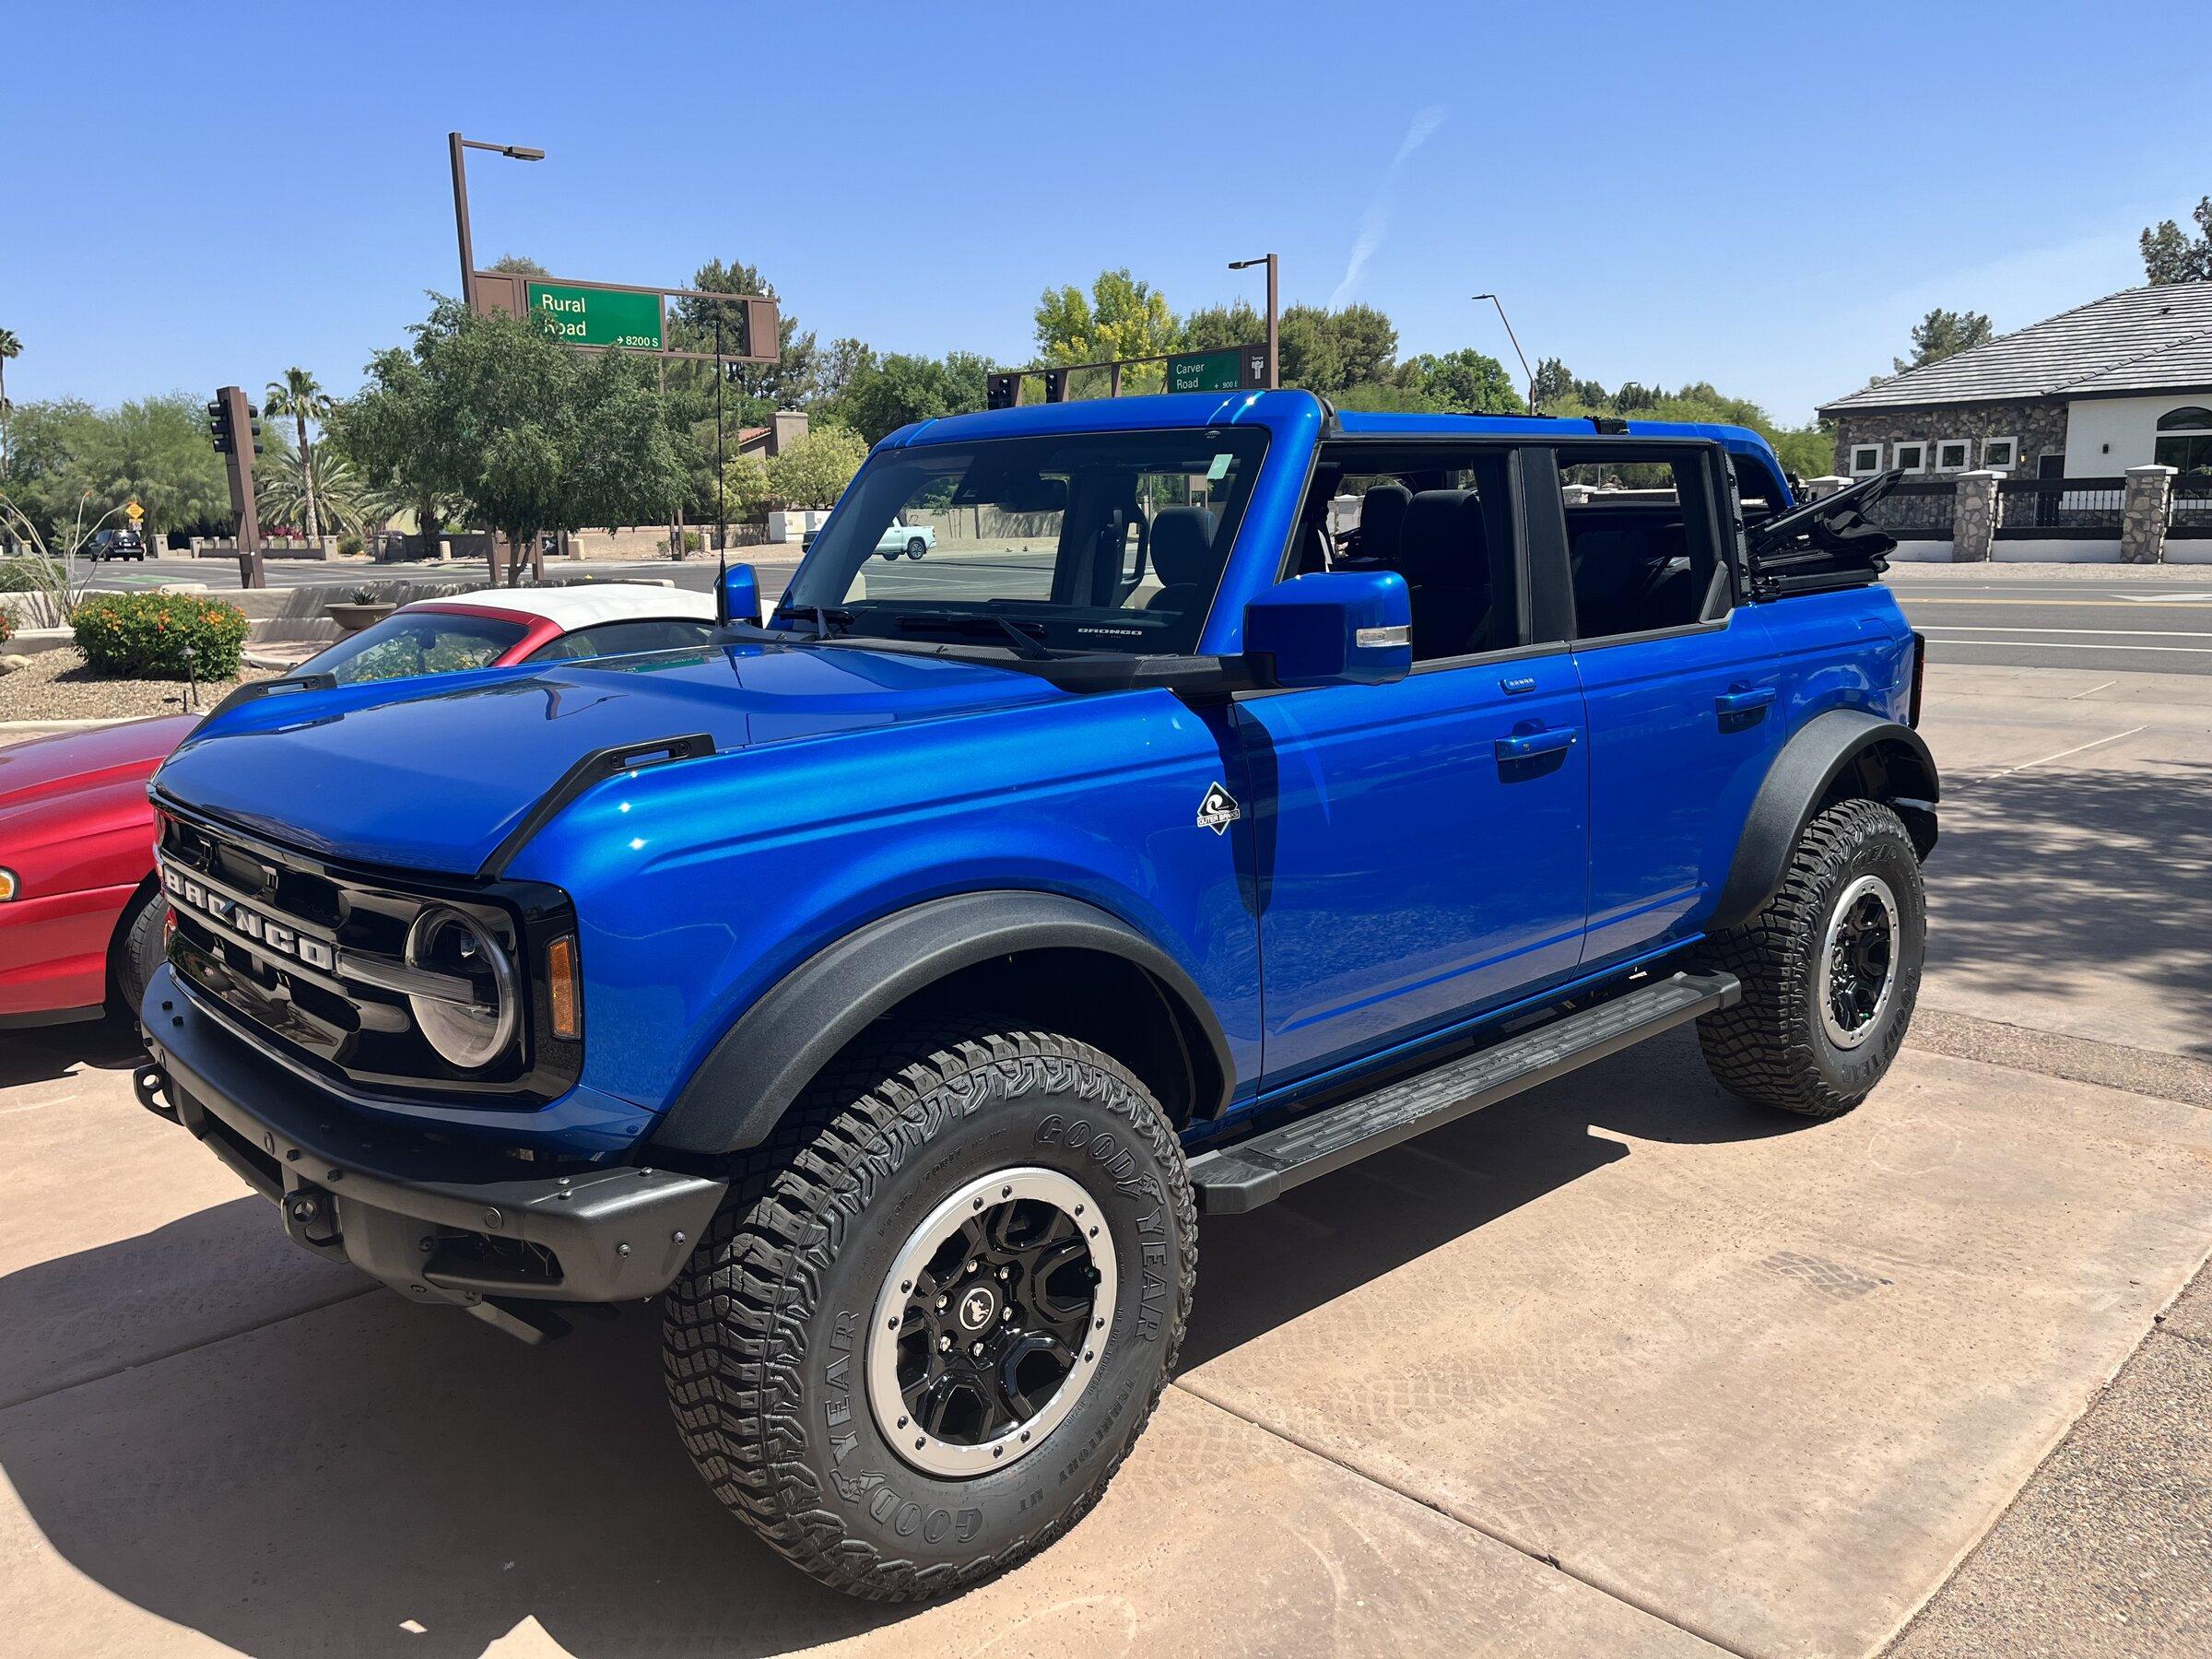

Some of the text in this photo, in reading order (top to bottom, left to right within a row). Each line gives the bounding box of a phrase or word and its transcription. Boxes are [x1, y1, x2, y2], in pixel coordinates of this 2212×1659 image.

[542, 294, 586, 313] Rural
[625, 335, 659, 347] 8200 S
[1176, 363, 1205, 375] Carver
[1176, 378, 1199, 390] Road
[1199, 816, 1218, 826] OUTER
[164, 865, 334, 971] BRONCO
